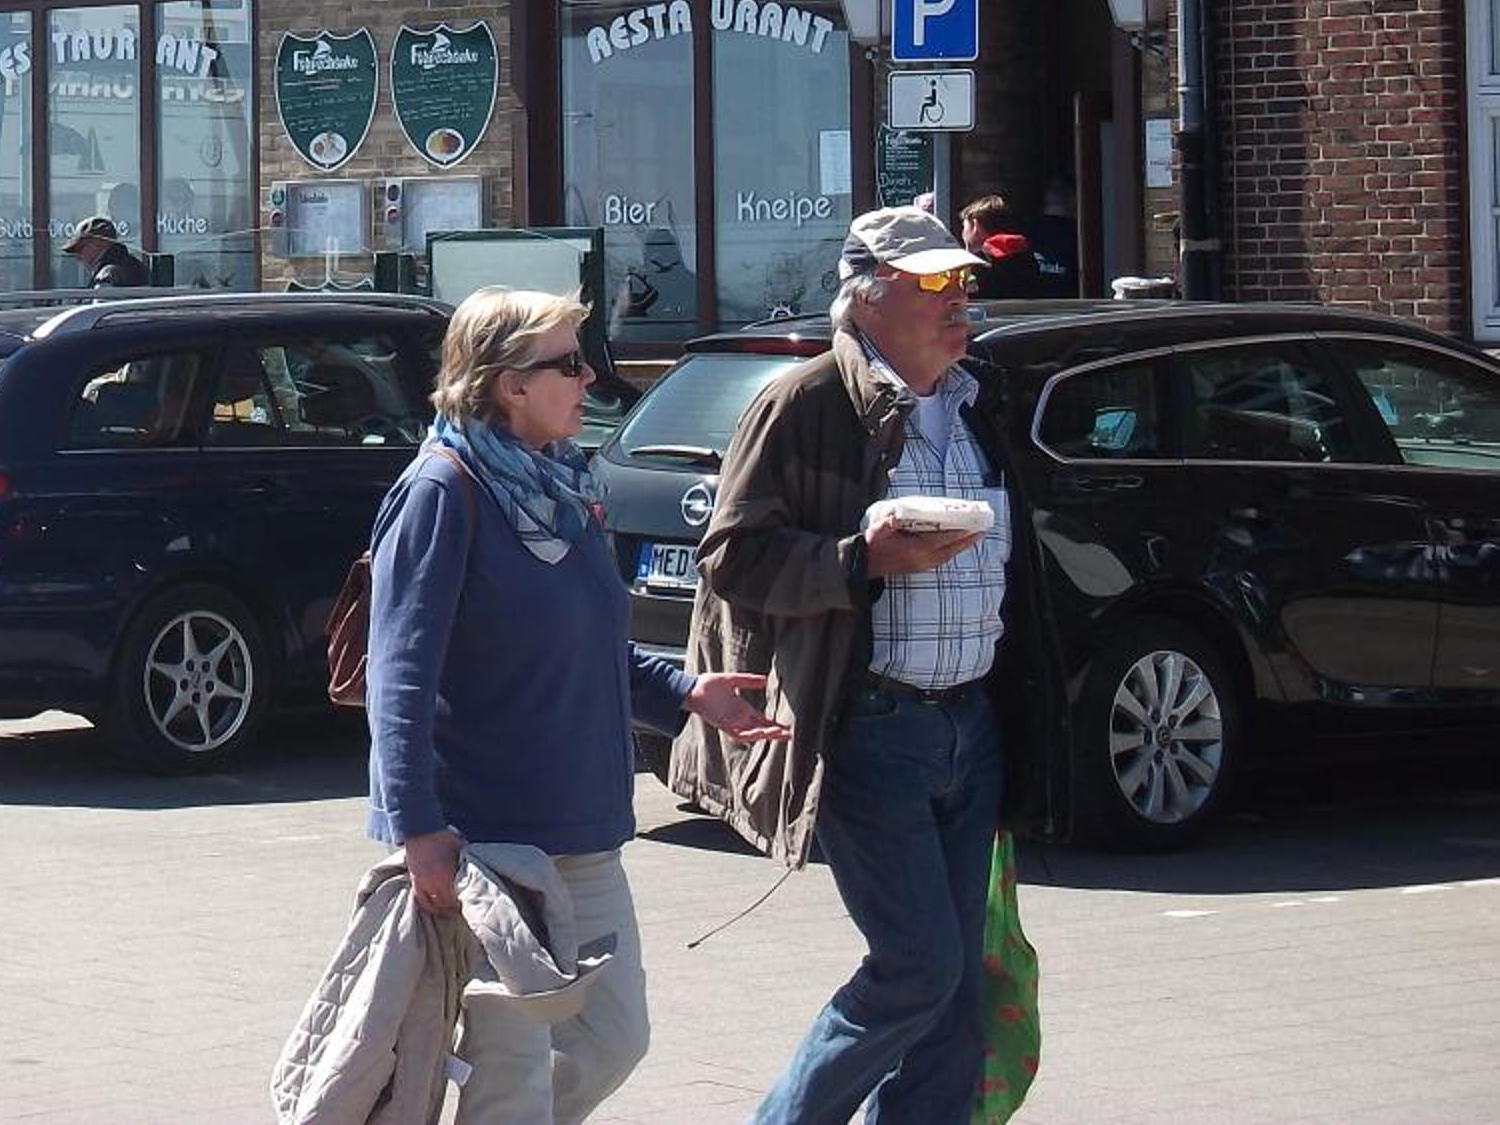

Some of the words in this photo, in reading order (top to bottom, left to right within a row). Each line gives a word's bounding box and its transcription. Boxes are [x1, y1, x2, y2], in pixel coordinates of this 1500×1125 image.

[605, 195, 655, 225] Bier
[736, 191, 832, 226] Kneipe
[651, 549, 689, 576] MED
